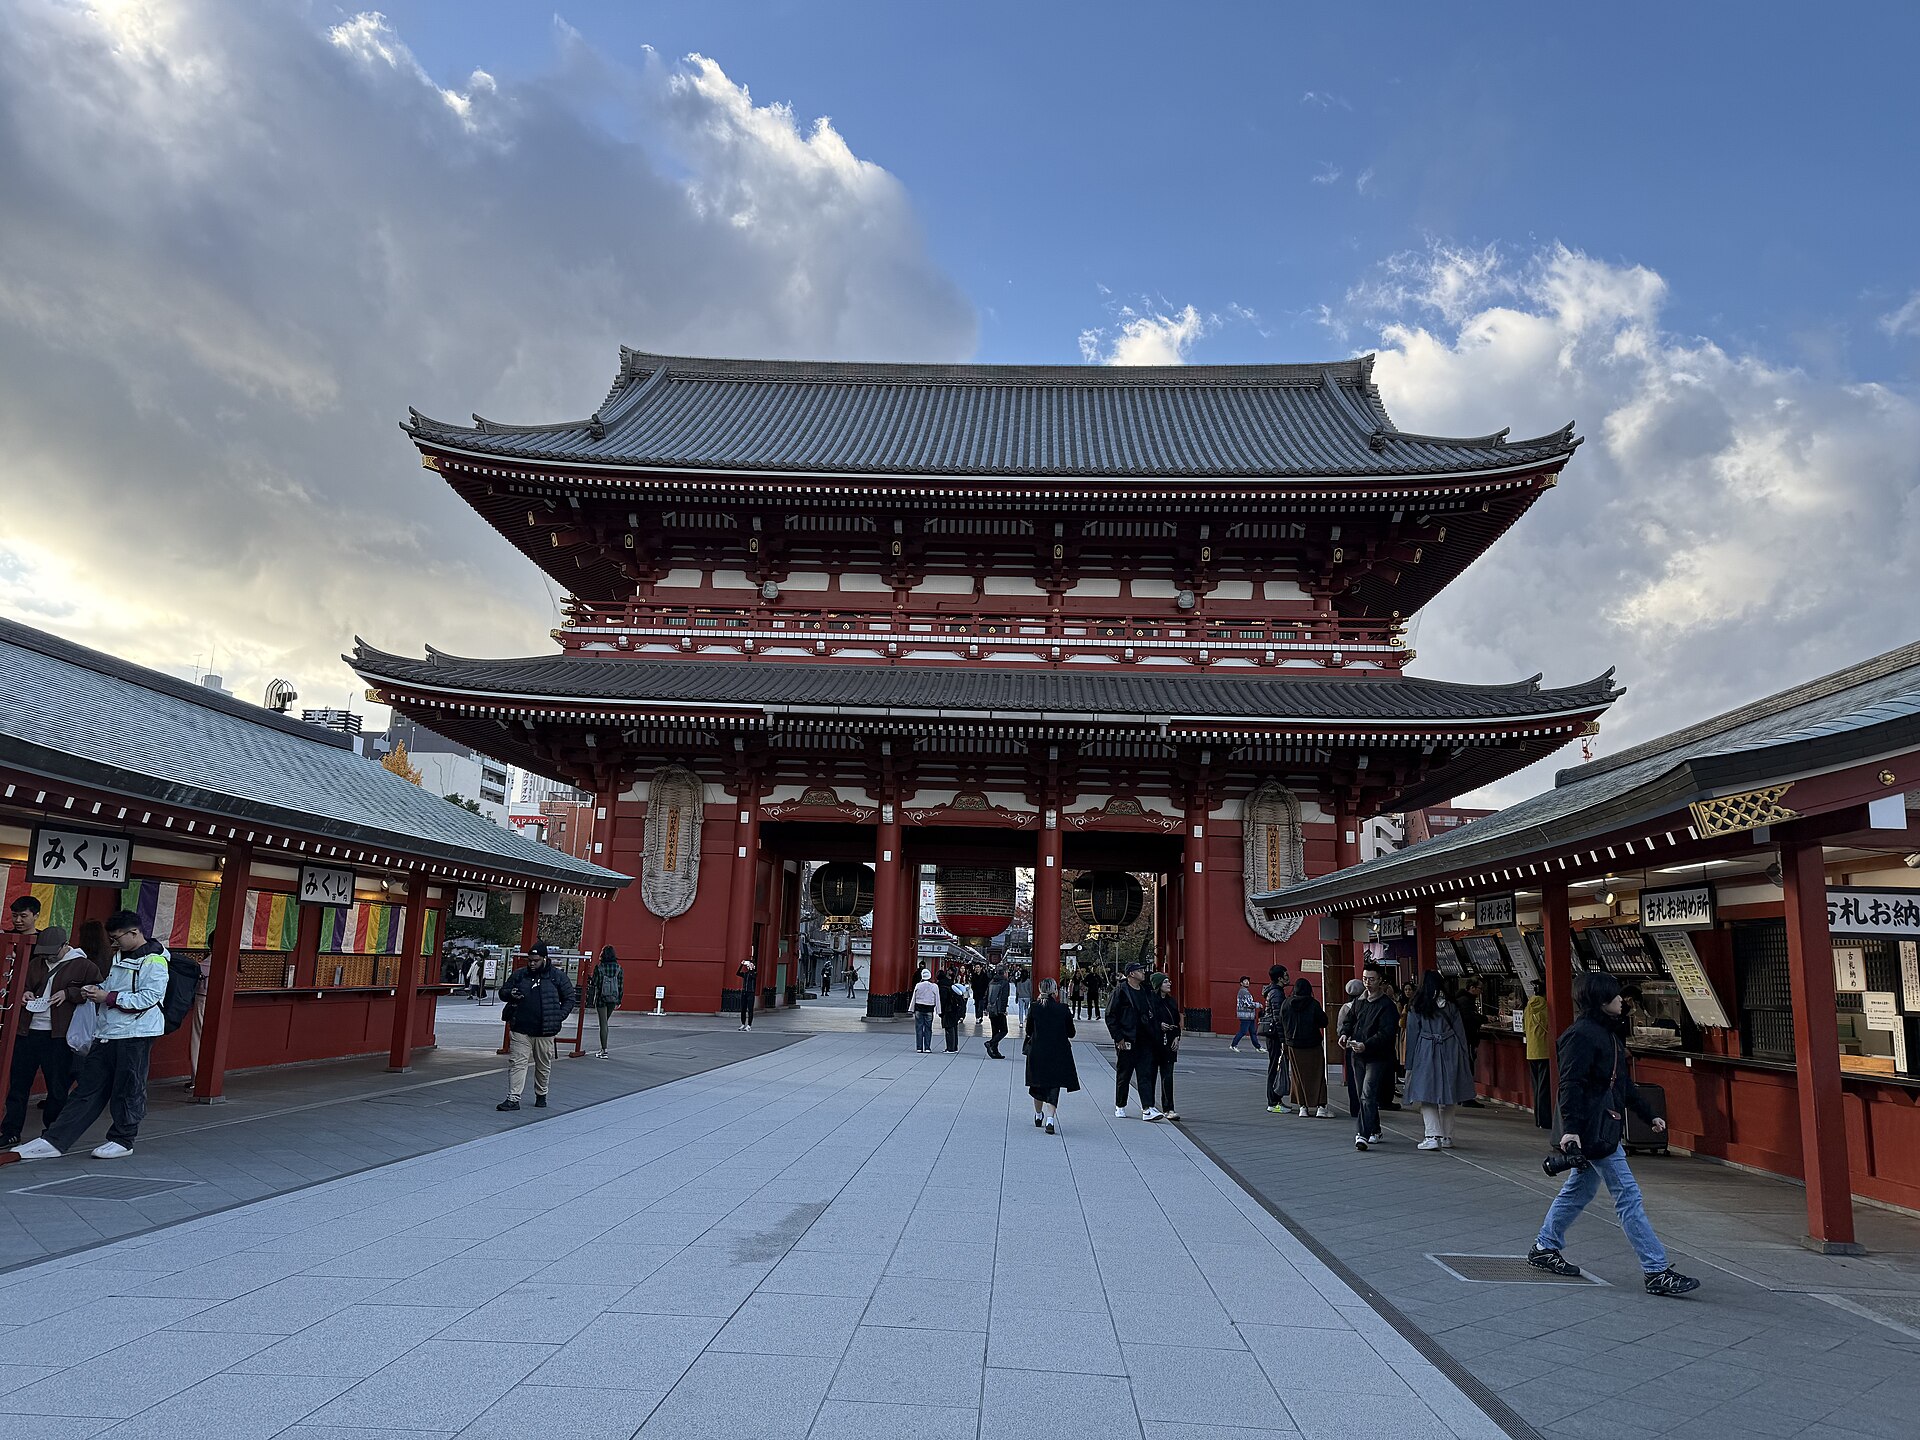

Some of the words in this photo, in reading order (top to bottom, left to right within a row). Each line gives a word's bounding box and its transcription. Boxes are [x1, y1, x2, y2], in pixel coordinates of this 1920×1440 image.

[43, 838, 119, 871] みくじ
[305, 872, 347, 896] みくじ
[458, 893, 484, 912] みくじ
[1647, 894, 1709, 921] 古札お納め所
